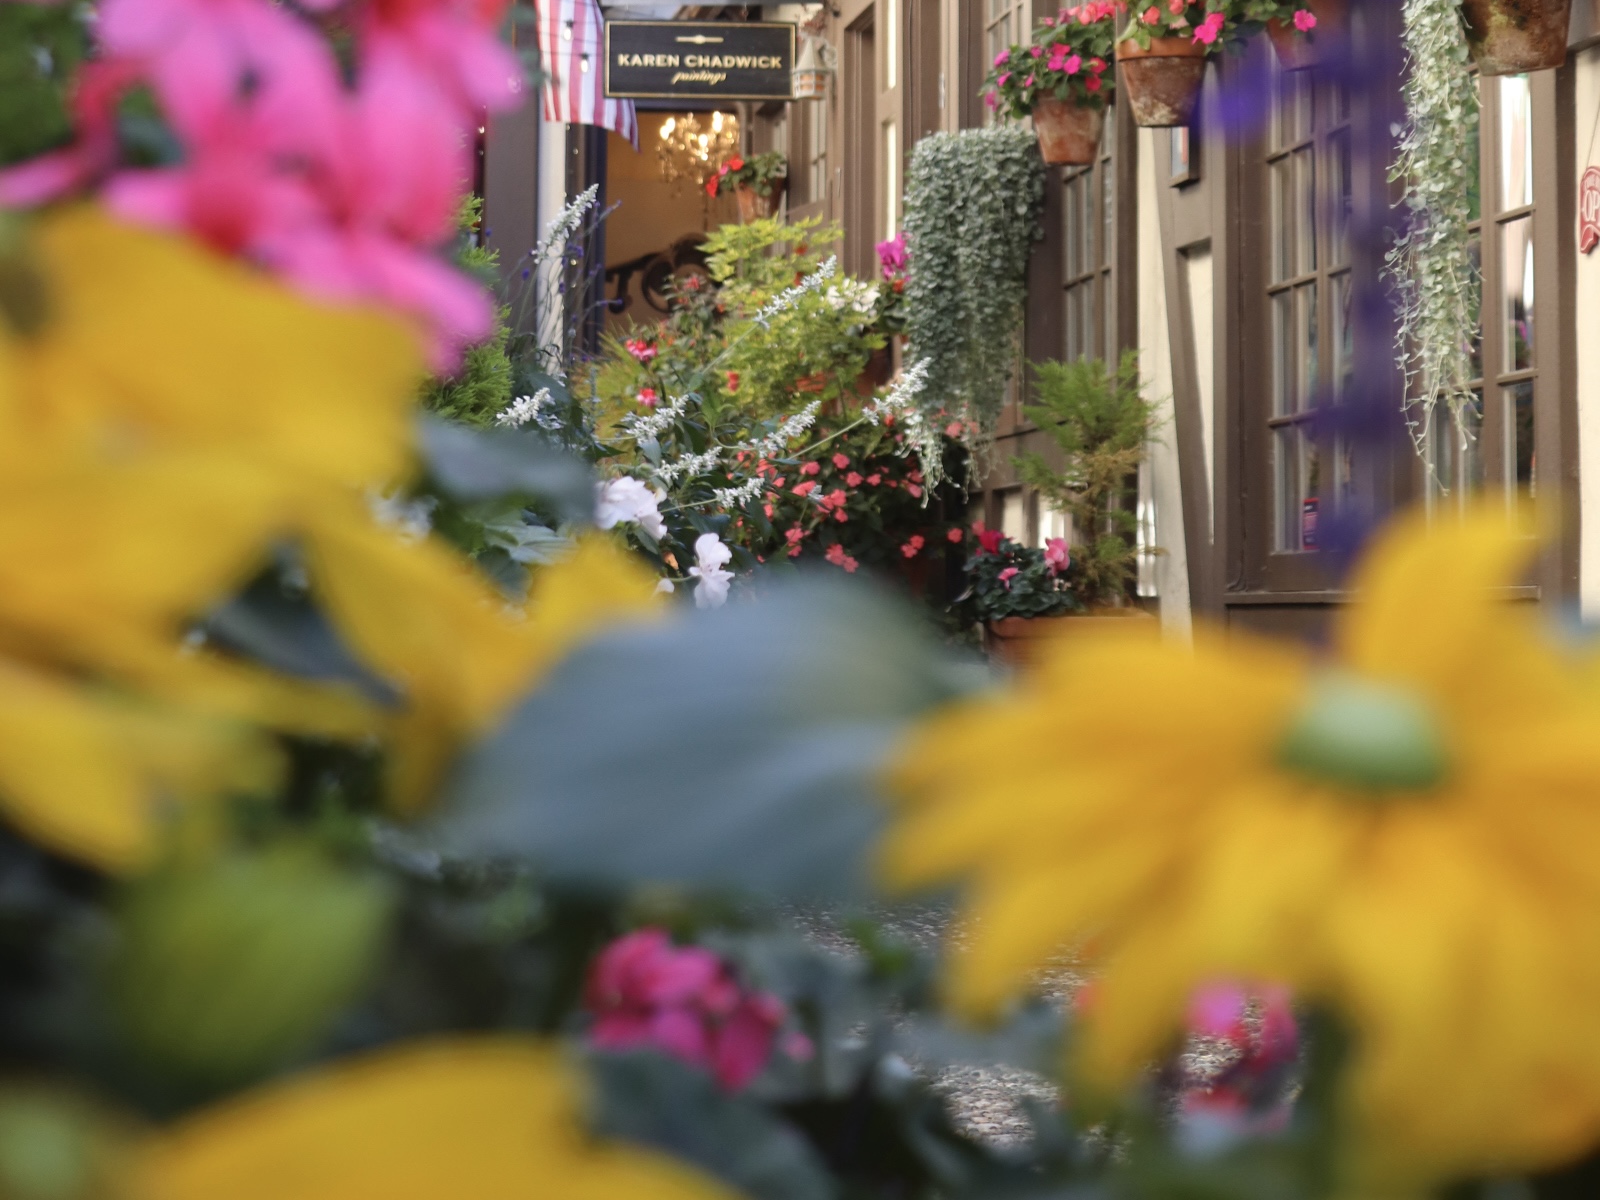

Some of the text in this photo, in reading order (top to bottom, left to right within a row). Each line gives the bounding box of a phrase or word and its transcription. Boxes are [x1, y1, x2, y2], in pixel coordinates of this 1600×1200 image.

[617, 53, 783, 69] KAREN CHADWICK
[670, 70, 727, 86] paintings
[1584, 189, 1600, 225] OP
